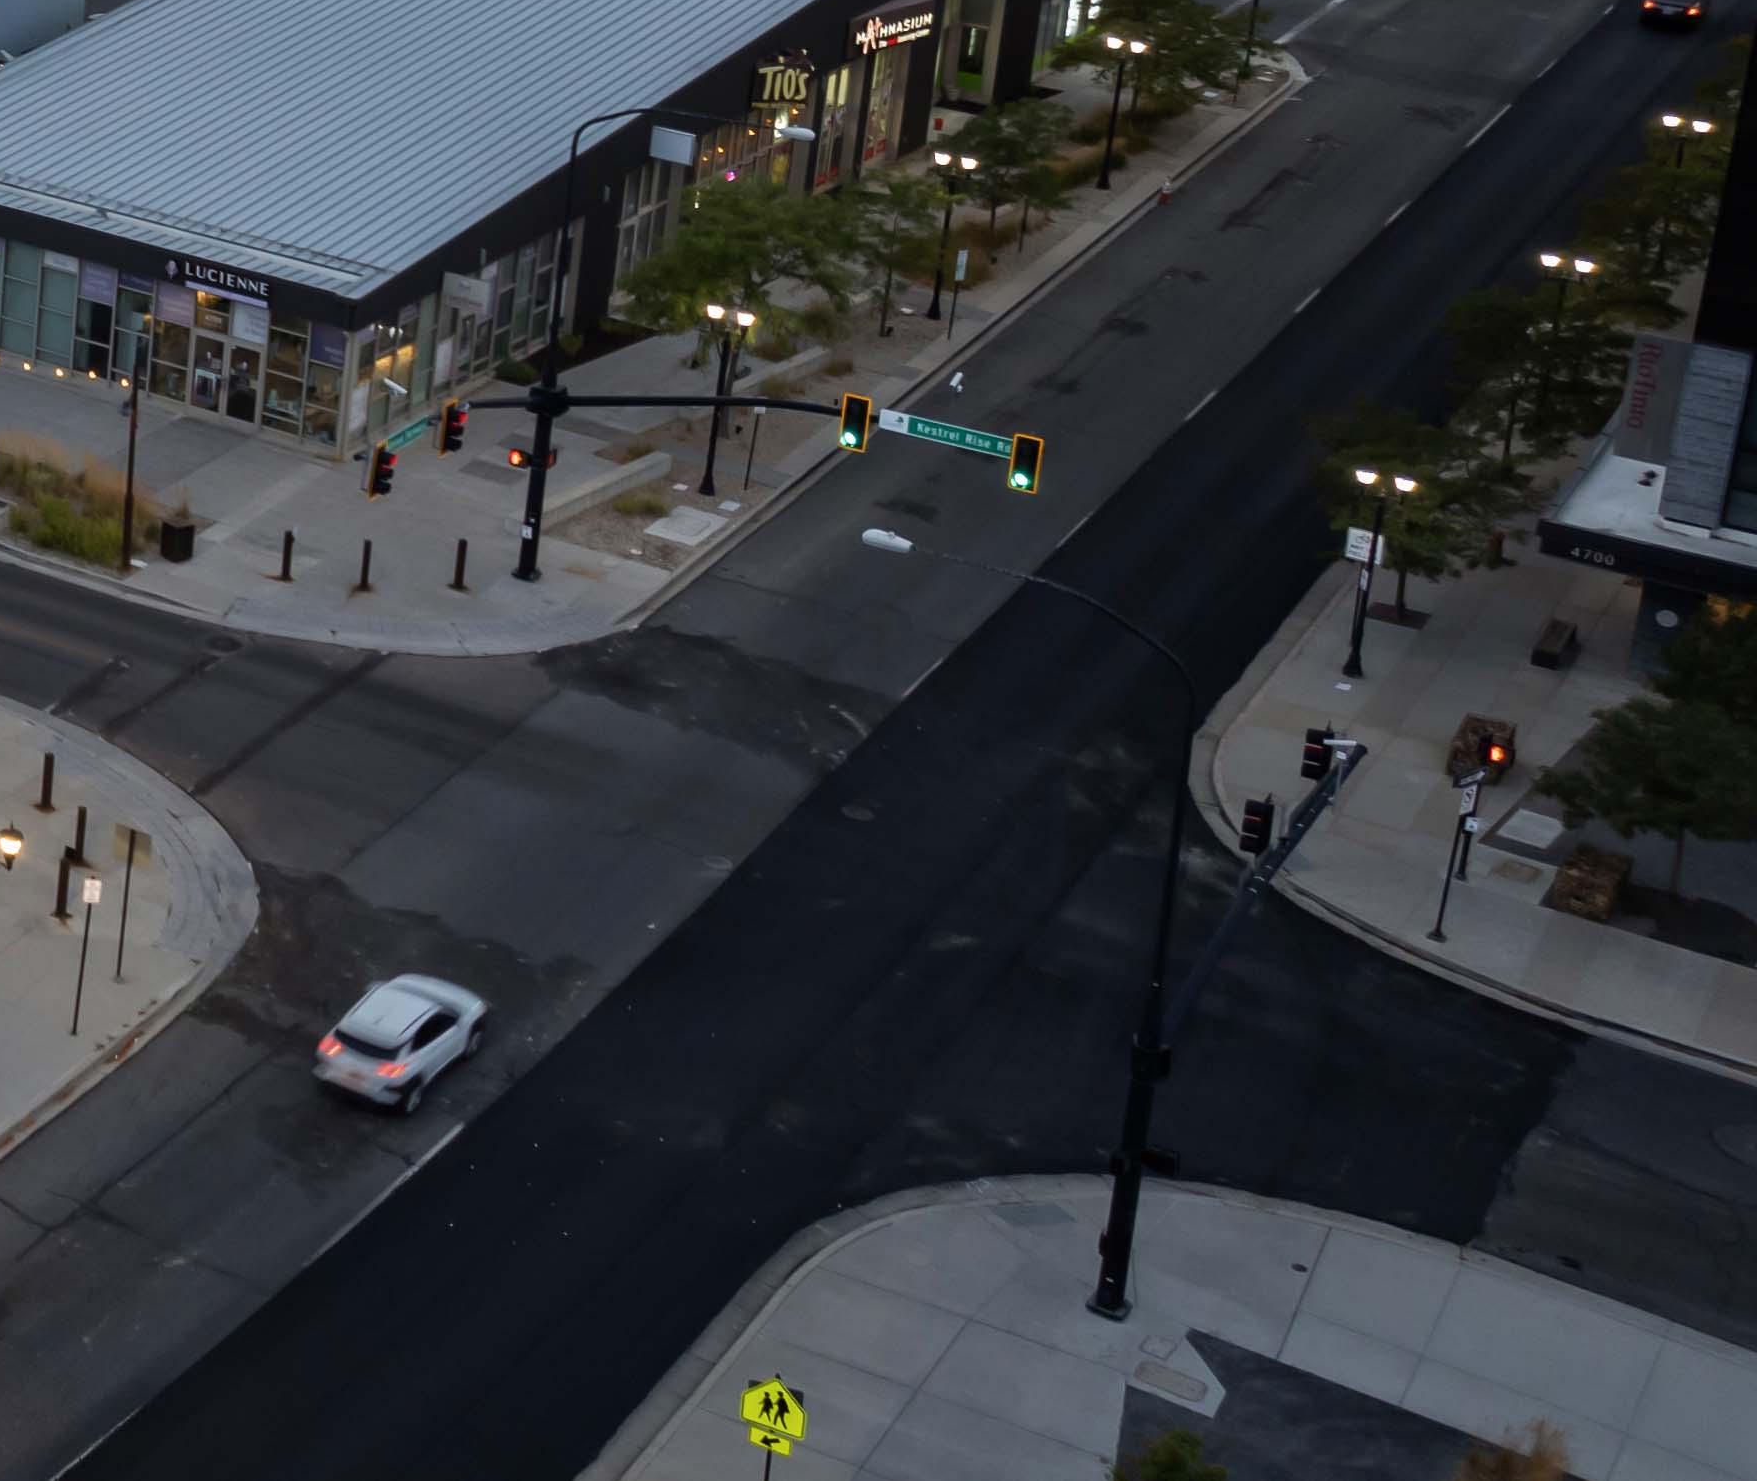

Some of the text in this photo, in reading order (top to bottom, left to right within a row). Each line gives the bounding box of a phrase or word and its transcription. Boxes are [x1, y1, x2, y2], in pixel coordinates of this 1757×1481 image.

[856, 13, 934, 54] MATHNASIUM
[184, 262, 270, 297] LUCIENNE
[916, 422, 960, 442] Kestrel
[964, 433, 992, 449] Rise
[1569, 547, 1615, 566] 4700
